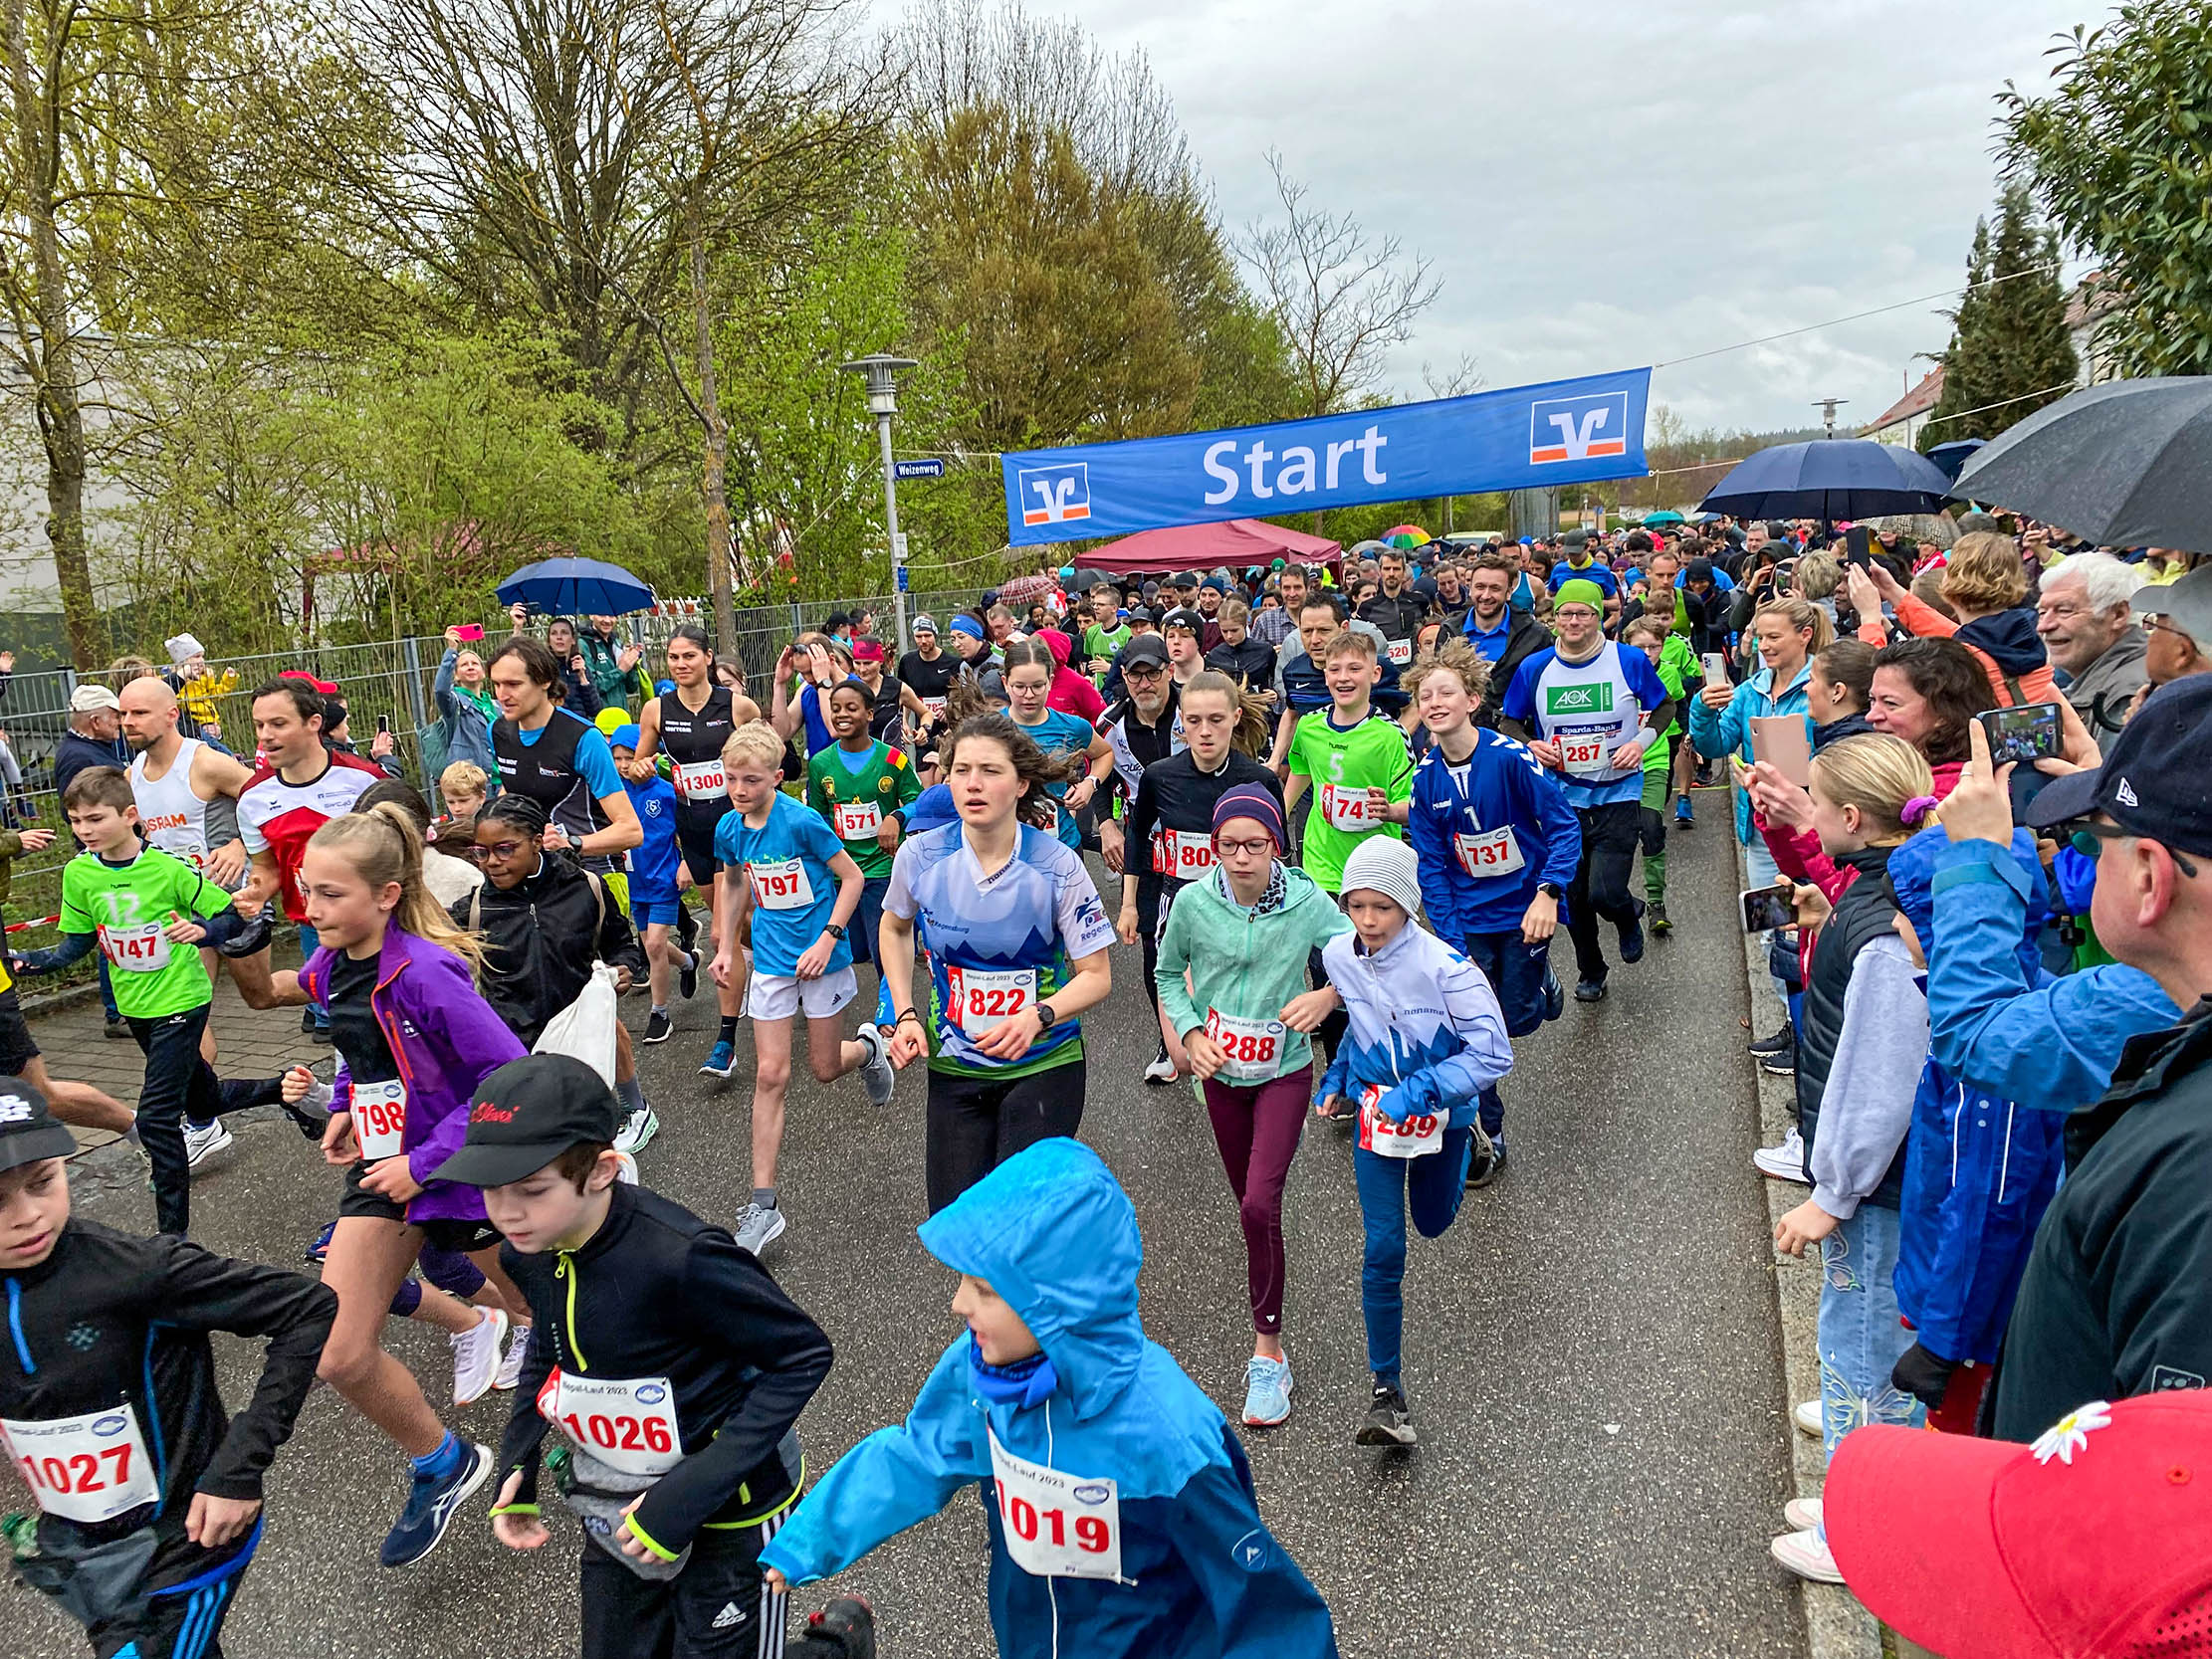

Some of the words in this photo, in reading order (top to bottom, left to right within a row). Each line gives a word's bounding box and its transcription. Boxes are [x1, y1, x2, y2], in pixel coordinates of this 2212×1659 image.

[898, 464, 940, 477] Weizenweg
[1203, 424, 1389, 506] Start
[1388, 645, 1409, 659] 520
[1555, 689, 1593, 707] AOK
[1561, 724, 1618, 735] Sparda-Bank
[1566, 743, 1601, 763] 287
[1328, 752, 1345, 782] 5
[684, 772, 724, 792] 1300
[1337, 798, 1374, 820] 74
[1463, 805, 1482, 832] 1
[845, 811, 876, 830] 571
[1181, 845, 1217, 867] 80
[1465, 840, 1508, 866] 737
[758, 873, 798, 897] 797
[102, 892, 143, 924] 12
[111, 935, 157, 958] 747
[969, 988, 1026, 1017] 822
[1403, 1006, 1445, 1016] noname
[1221, 1031, 1275, 1063] 288
[358, 1101, 405, 1138] 798
[606, 1385, 628, 1395] 2023
[562, 1412, 672, 1454] 1026
[21, 1442, 132, 1495] 1027
[1038, 1475, 1065, 1489] 2023
